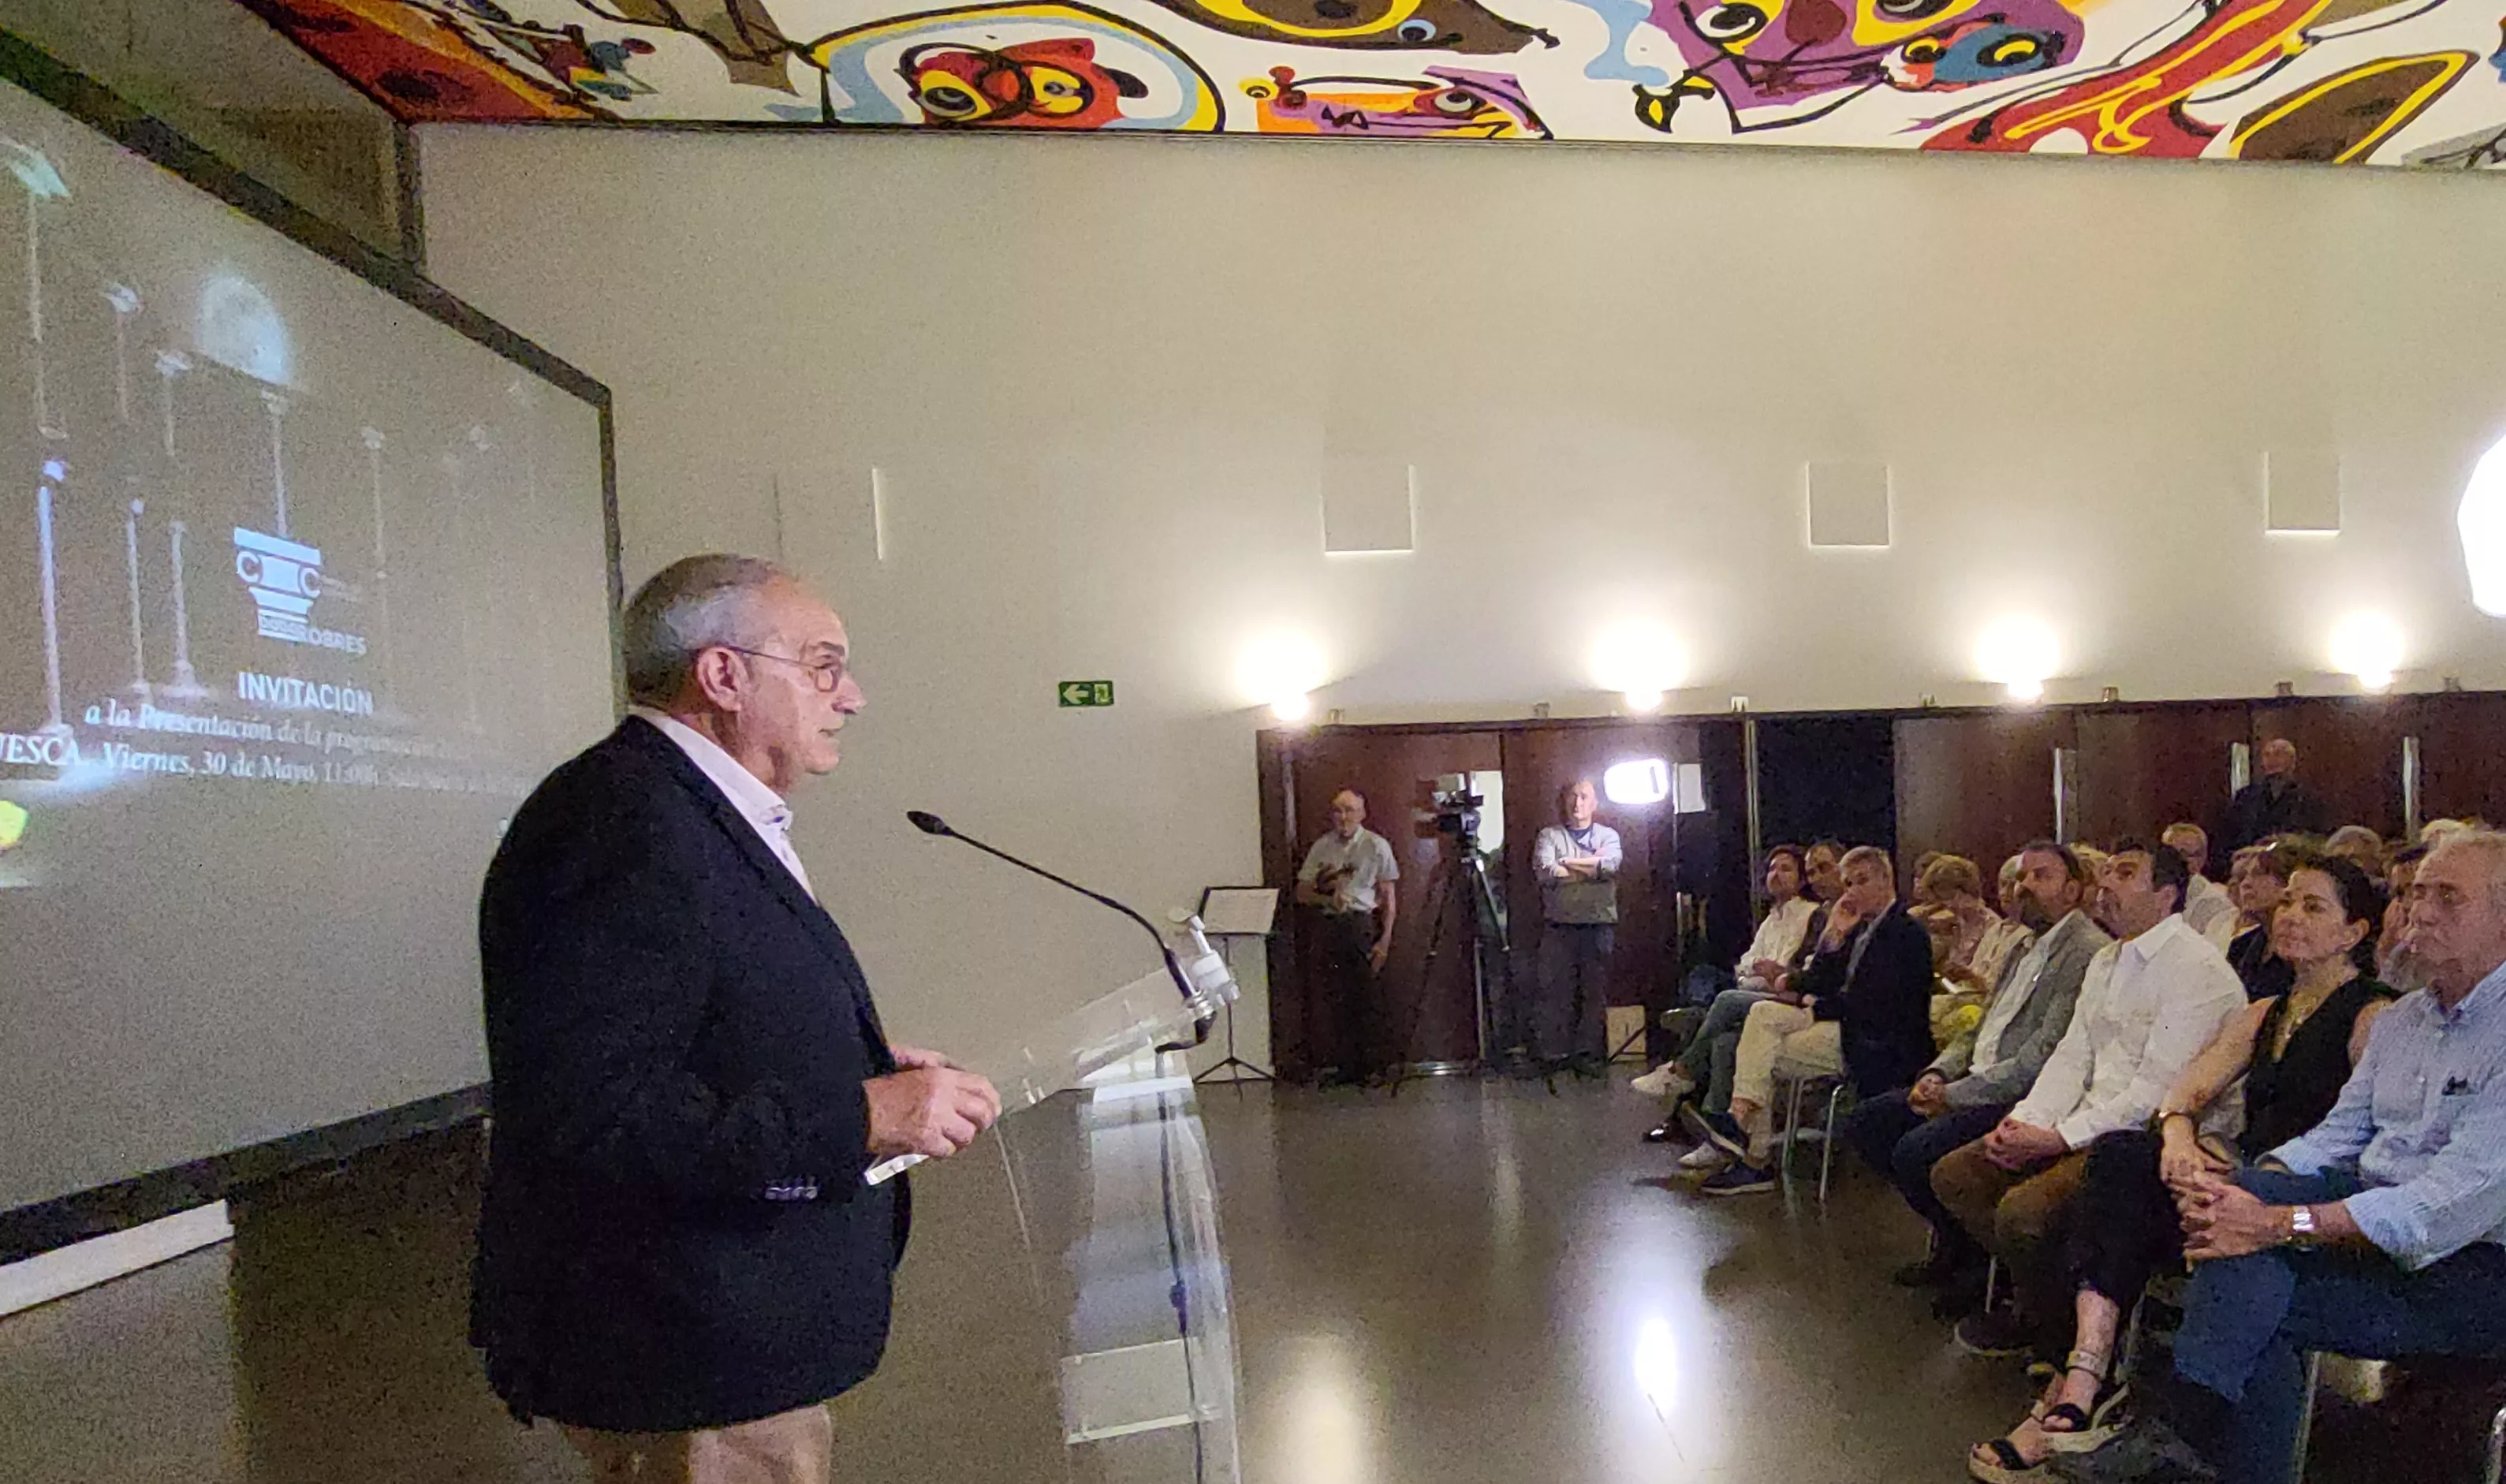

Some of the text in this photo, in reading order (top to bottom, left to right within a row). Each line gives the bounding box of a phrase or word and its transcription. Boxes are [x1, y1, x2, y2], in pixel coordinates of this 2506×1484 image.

[238, 671, 374, 716] INVITACIÓN
[84, 705, 101, 725] a
[108, 697, 131, 727] la
[200, 750, 226, 776] 30
[230, 751, 253, 777] de
